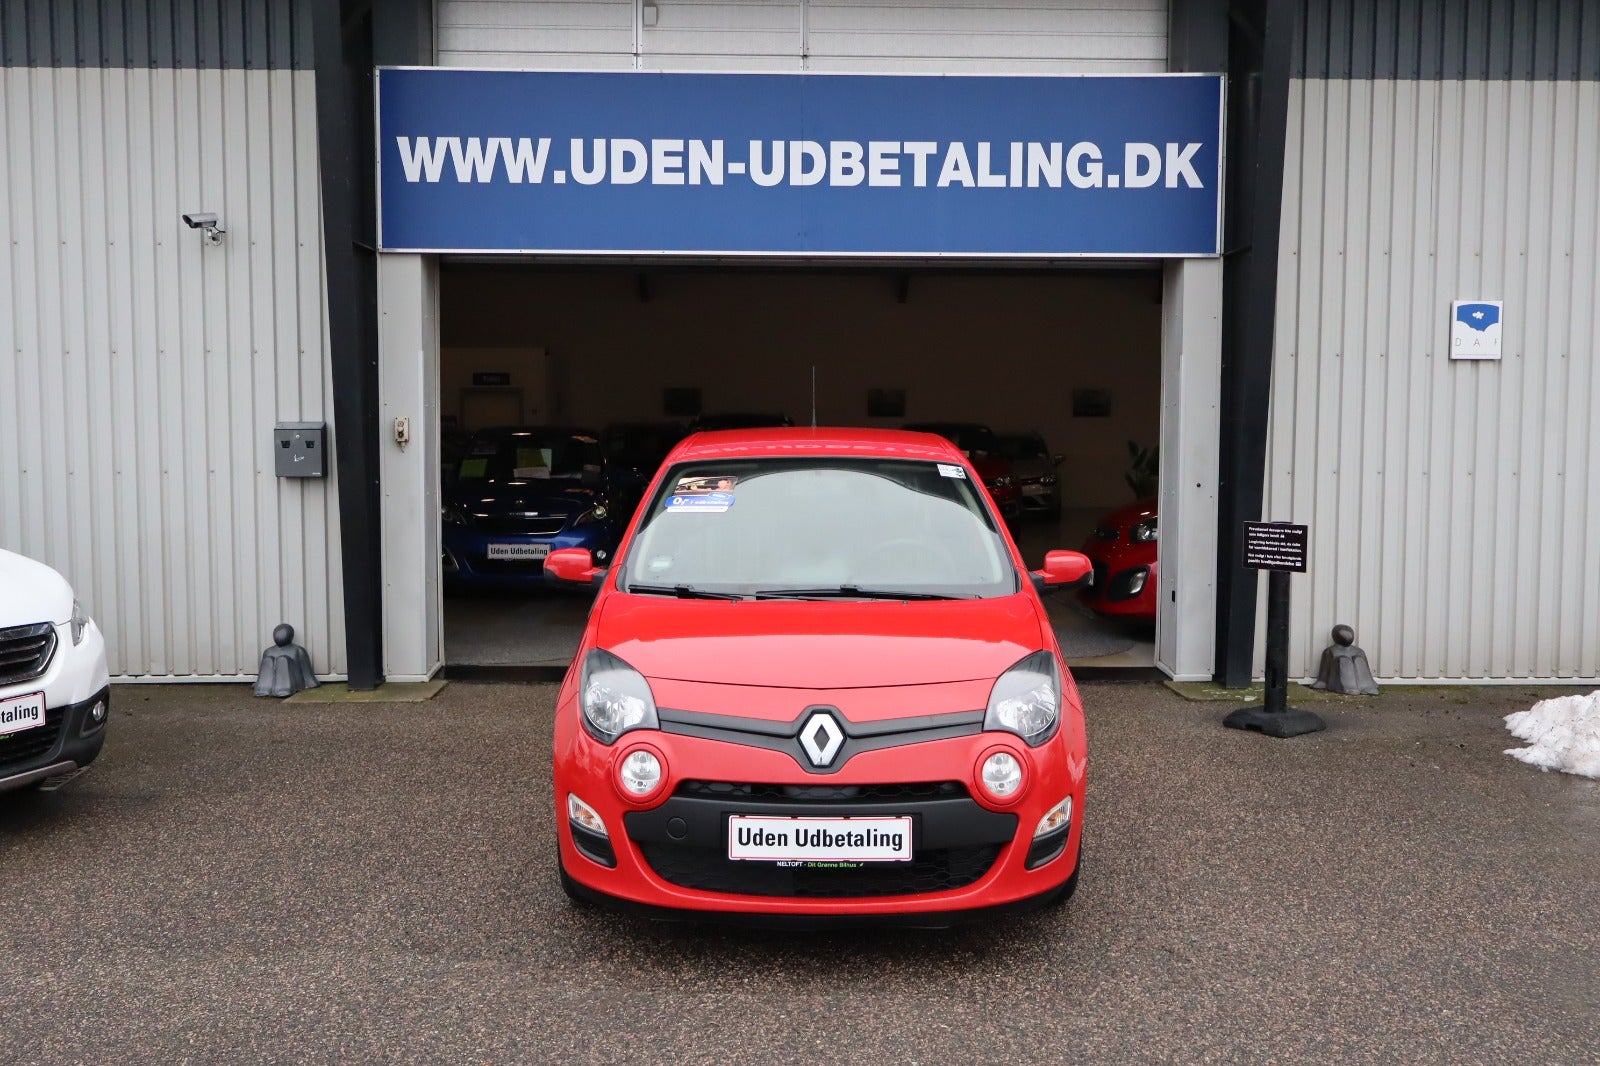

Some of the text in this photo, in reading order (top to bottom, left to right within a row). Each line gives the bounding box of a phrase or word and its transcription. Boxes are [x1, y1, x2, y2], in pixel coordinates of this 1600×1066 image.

[396, 136, 1204, 190] WWW.UDEN-UDBETALING.DK
[490, 547, 548, 556] Uden Udbetaling
[738, 827, 903, 852] Uden Udbetaling
